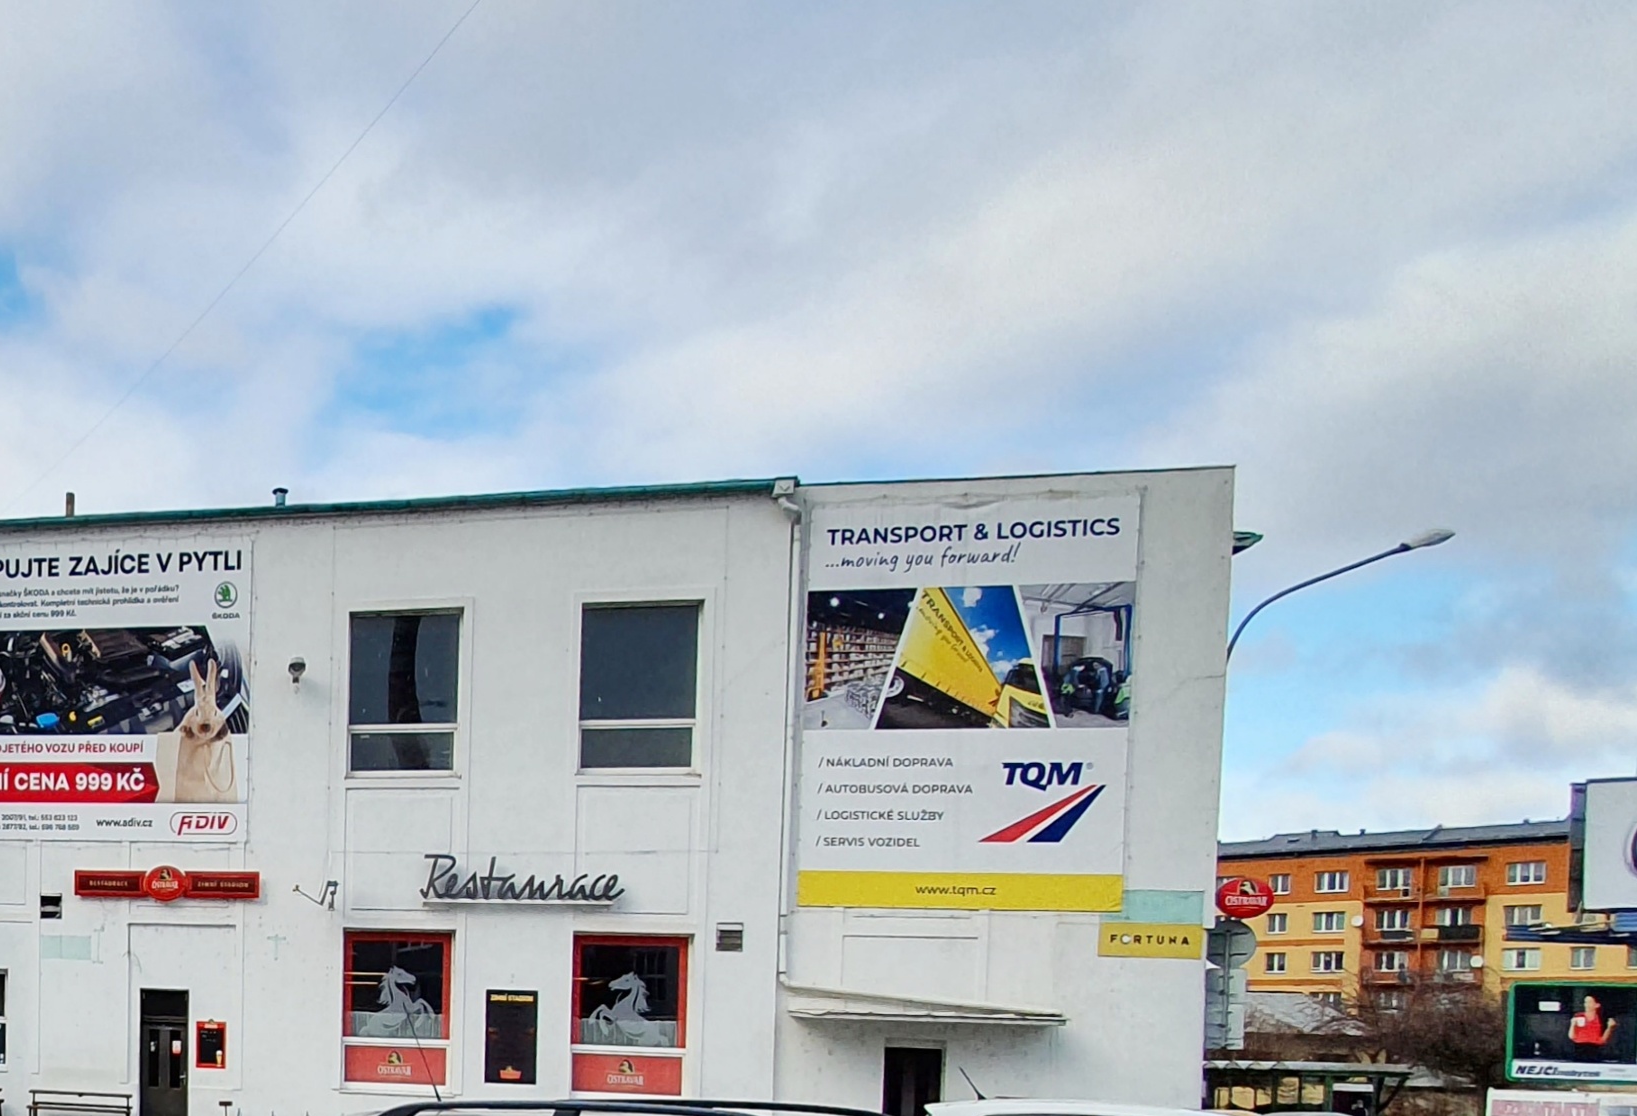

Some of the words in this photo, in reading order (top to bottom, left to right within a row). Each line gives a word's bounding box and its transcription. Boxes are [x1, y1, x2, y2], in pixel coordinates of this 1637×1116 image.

[827, 523, 967, 546] TRANSPORT
[974, 523, 989, 540] &
[996, 517, 1121, 541] LOGISTICS
[68, 550, 150, 576] ZAJÍCE
[156, 553, 172, 573] V
[178, 550, 242, 572] PYTLI
[905, 552, 933, 573] you
[940, 542, 1022, 568] forward!
[23, 587, 50, 597] ŠKODA
[56, 588, 81, 596] chcete
[145, 585, 179, 595] pořádku?
[211, 610, 240, 619] ŠKODA
[921, 590, 964, 646] TRANSPORT
[45, 743, 76, 753] VOZU
[78, 740, 107, 753] PŘED
[109, 741, 143, 753] KOUPÍ
[826, 756, 890, 768] NÁKLADNÍ
[892, 758, 954, 768] DOPRAVA
[14, 773, 69, 790] CENA
[75, 772, 111, 791] 999
[116, 767, 145, 790] KČ
[1001, 762, 1084, 791] TQM
[825, 783, 909, 794] AUTOBUSOVÁ
[912, 784, 973, 794] DOPRAVA
[824, 808, 894, 820] LOGISTICKÉ
[897, 809, 944, 820] SLUŽBY
[96, 817, 153, 828] www.adiv.cz
[823, 836, 865, 847] SERVIS
[868, 837, 920, 847] VOZIDEL
[419, 854, 626, 901] Restaurace
[916, 884, 997, 897] www.tqm.cz
[1109, 934, 1190, 946] FORTUNA
